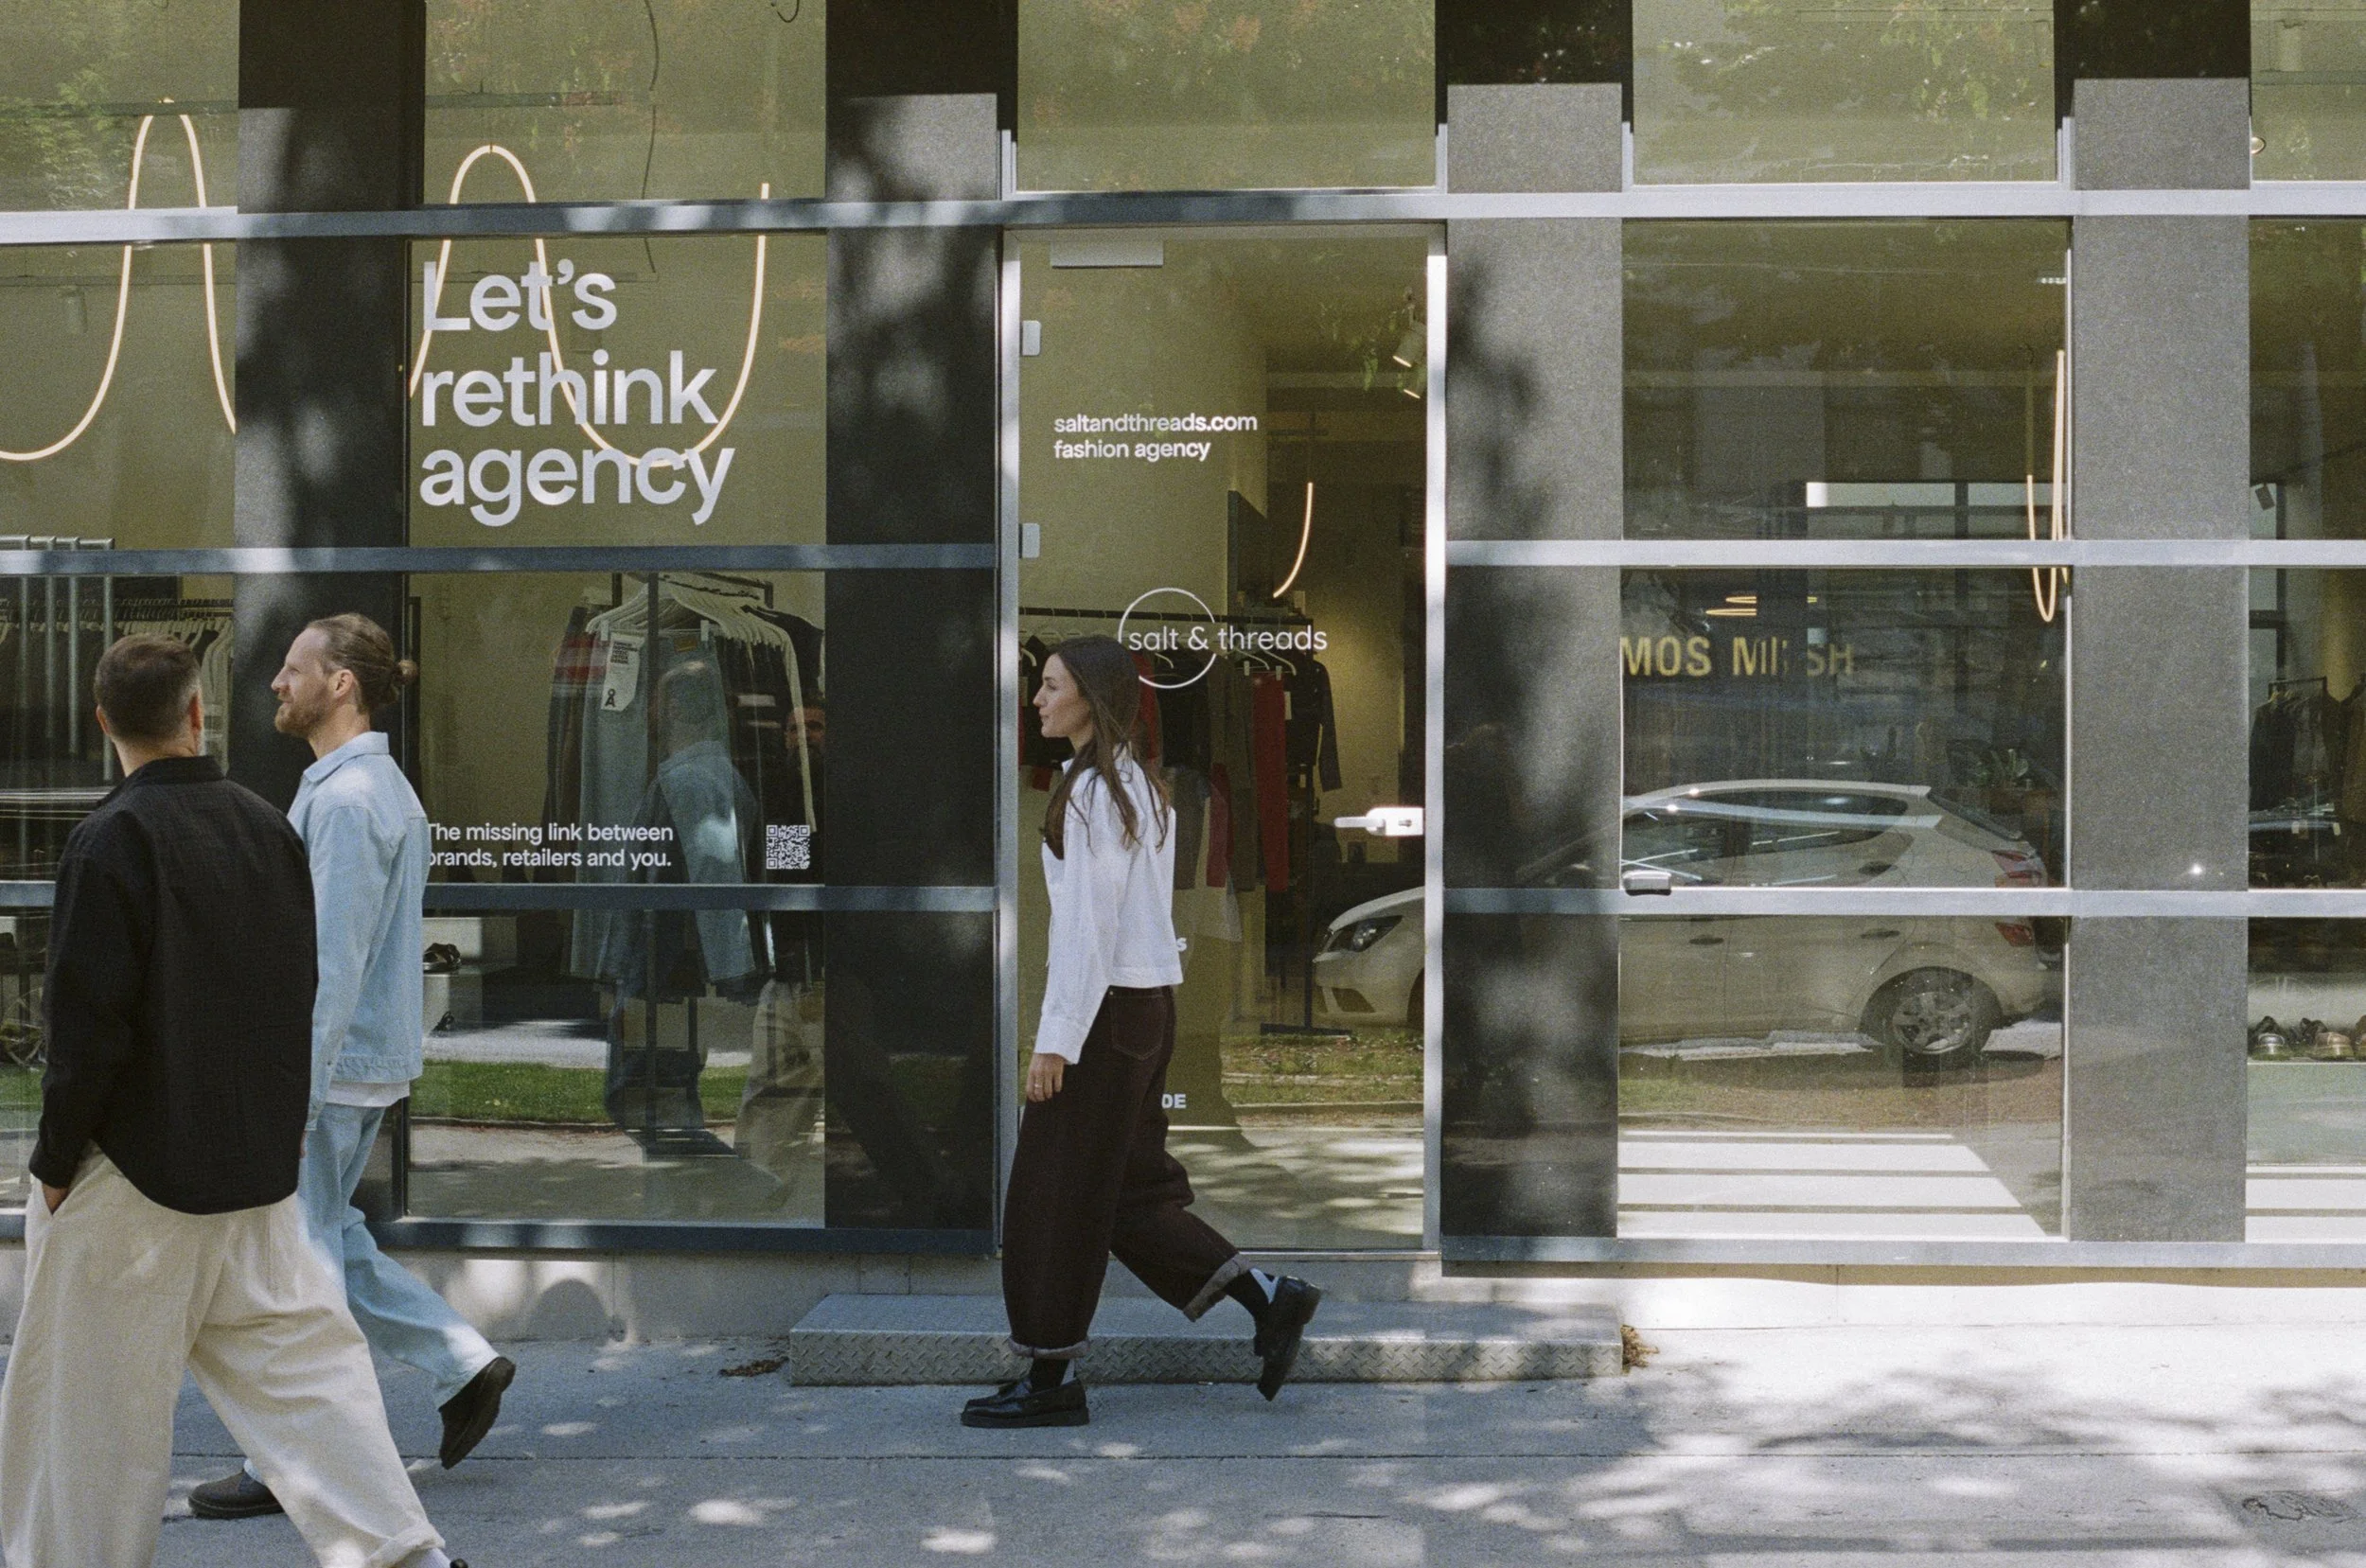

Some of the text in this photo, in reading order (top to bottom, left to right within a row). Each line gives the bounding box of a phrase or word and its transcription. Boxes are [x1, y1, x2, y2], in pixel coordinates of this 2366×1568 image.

[422, 349, 718, 427] rethink
[1053, 413, 1258, 432] saltandthreads.com
[1053, 439, 1211, 462] fashion agency
[419, 448, 735, 527] agency
[1128, 625, 1328, 651] salt & threads
[466, 822, 542, 846] missing
[548, 822, 583, 841] link
[587, 822, 674, 841] between
[503, 848, 582, 867] retailers
[586, 848, 625, 867] and
[629, 852, 672, 872] you.
